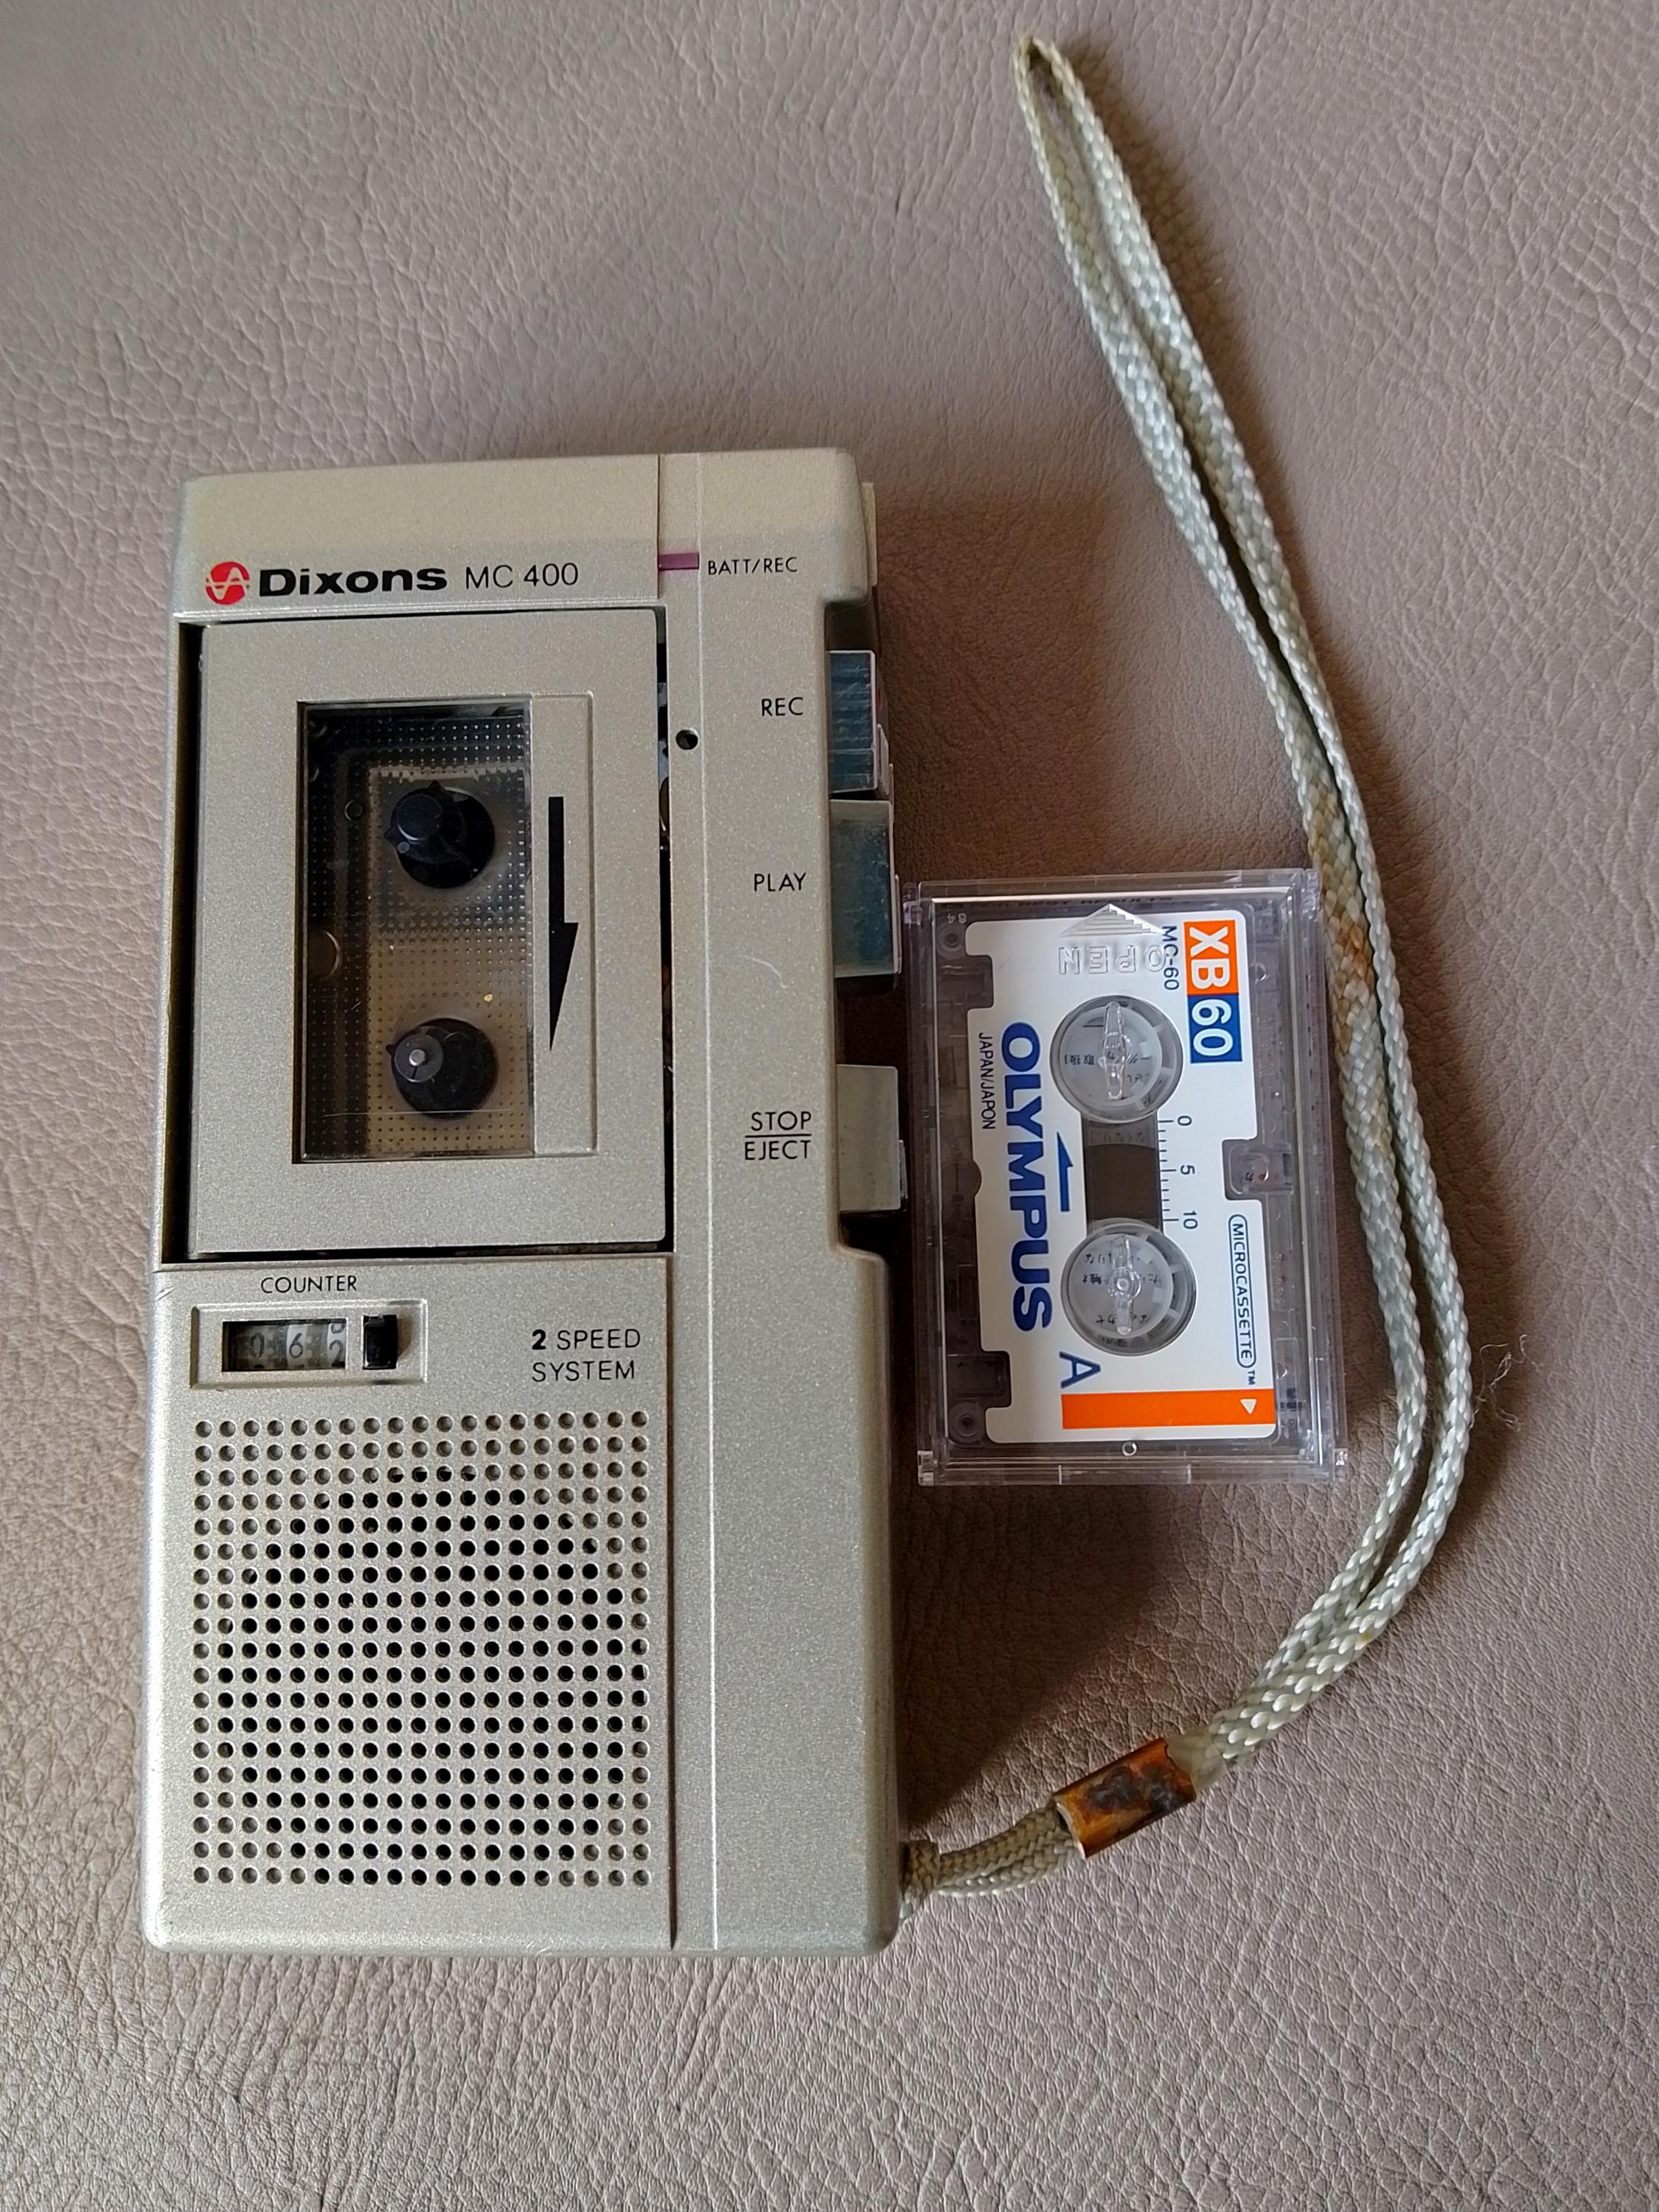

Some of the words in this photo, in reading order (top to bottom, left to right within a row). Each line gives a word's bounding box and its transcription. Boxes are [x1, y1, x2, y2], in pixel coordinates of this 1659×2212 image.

[708, 556, 799, 576] BATT/REC
[259, 567, 448, 597] Dixons
[465, 564, 513, 589] MC
[524, 563, 579, 587] 400
[761, 697, 804, 717] REC
[754, 872, 807, 892] PLAY
[1058, 945, 1166, 975] OPEN
[1161, 925, 1180, 991] MC-60
[1189, 926, 1231, 990] XB
[1192, 998, 1234, 1057] 60
[978, 1032, 996, 1130] JAPAN/JAPON
[751, 1110, 812, 1131] STOP
[1178, 1115, 1192, 1126] 0
[744, 1140, 811, 1161] EJECT
[1001, 1021, 1053, 1332] OLYMPUS
[1180, 1164, 1195, 1175] 5
[1183, 1211, 1198, 1229] 10
[260, 1275, 358, 1293] COUNTER
[1232, 1222, 1253, 1360] MICROCASSETTE
[532, 1329, 547, 1350] 2
[557, 1329, 641, 1350] SPEED
[532, 1360, 636, 1382] SYSTEM
[1059, 1352, 1099, 1389] A
